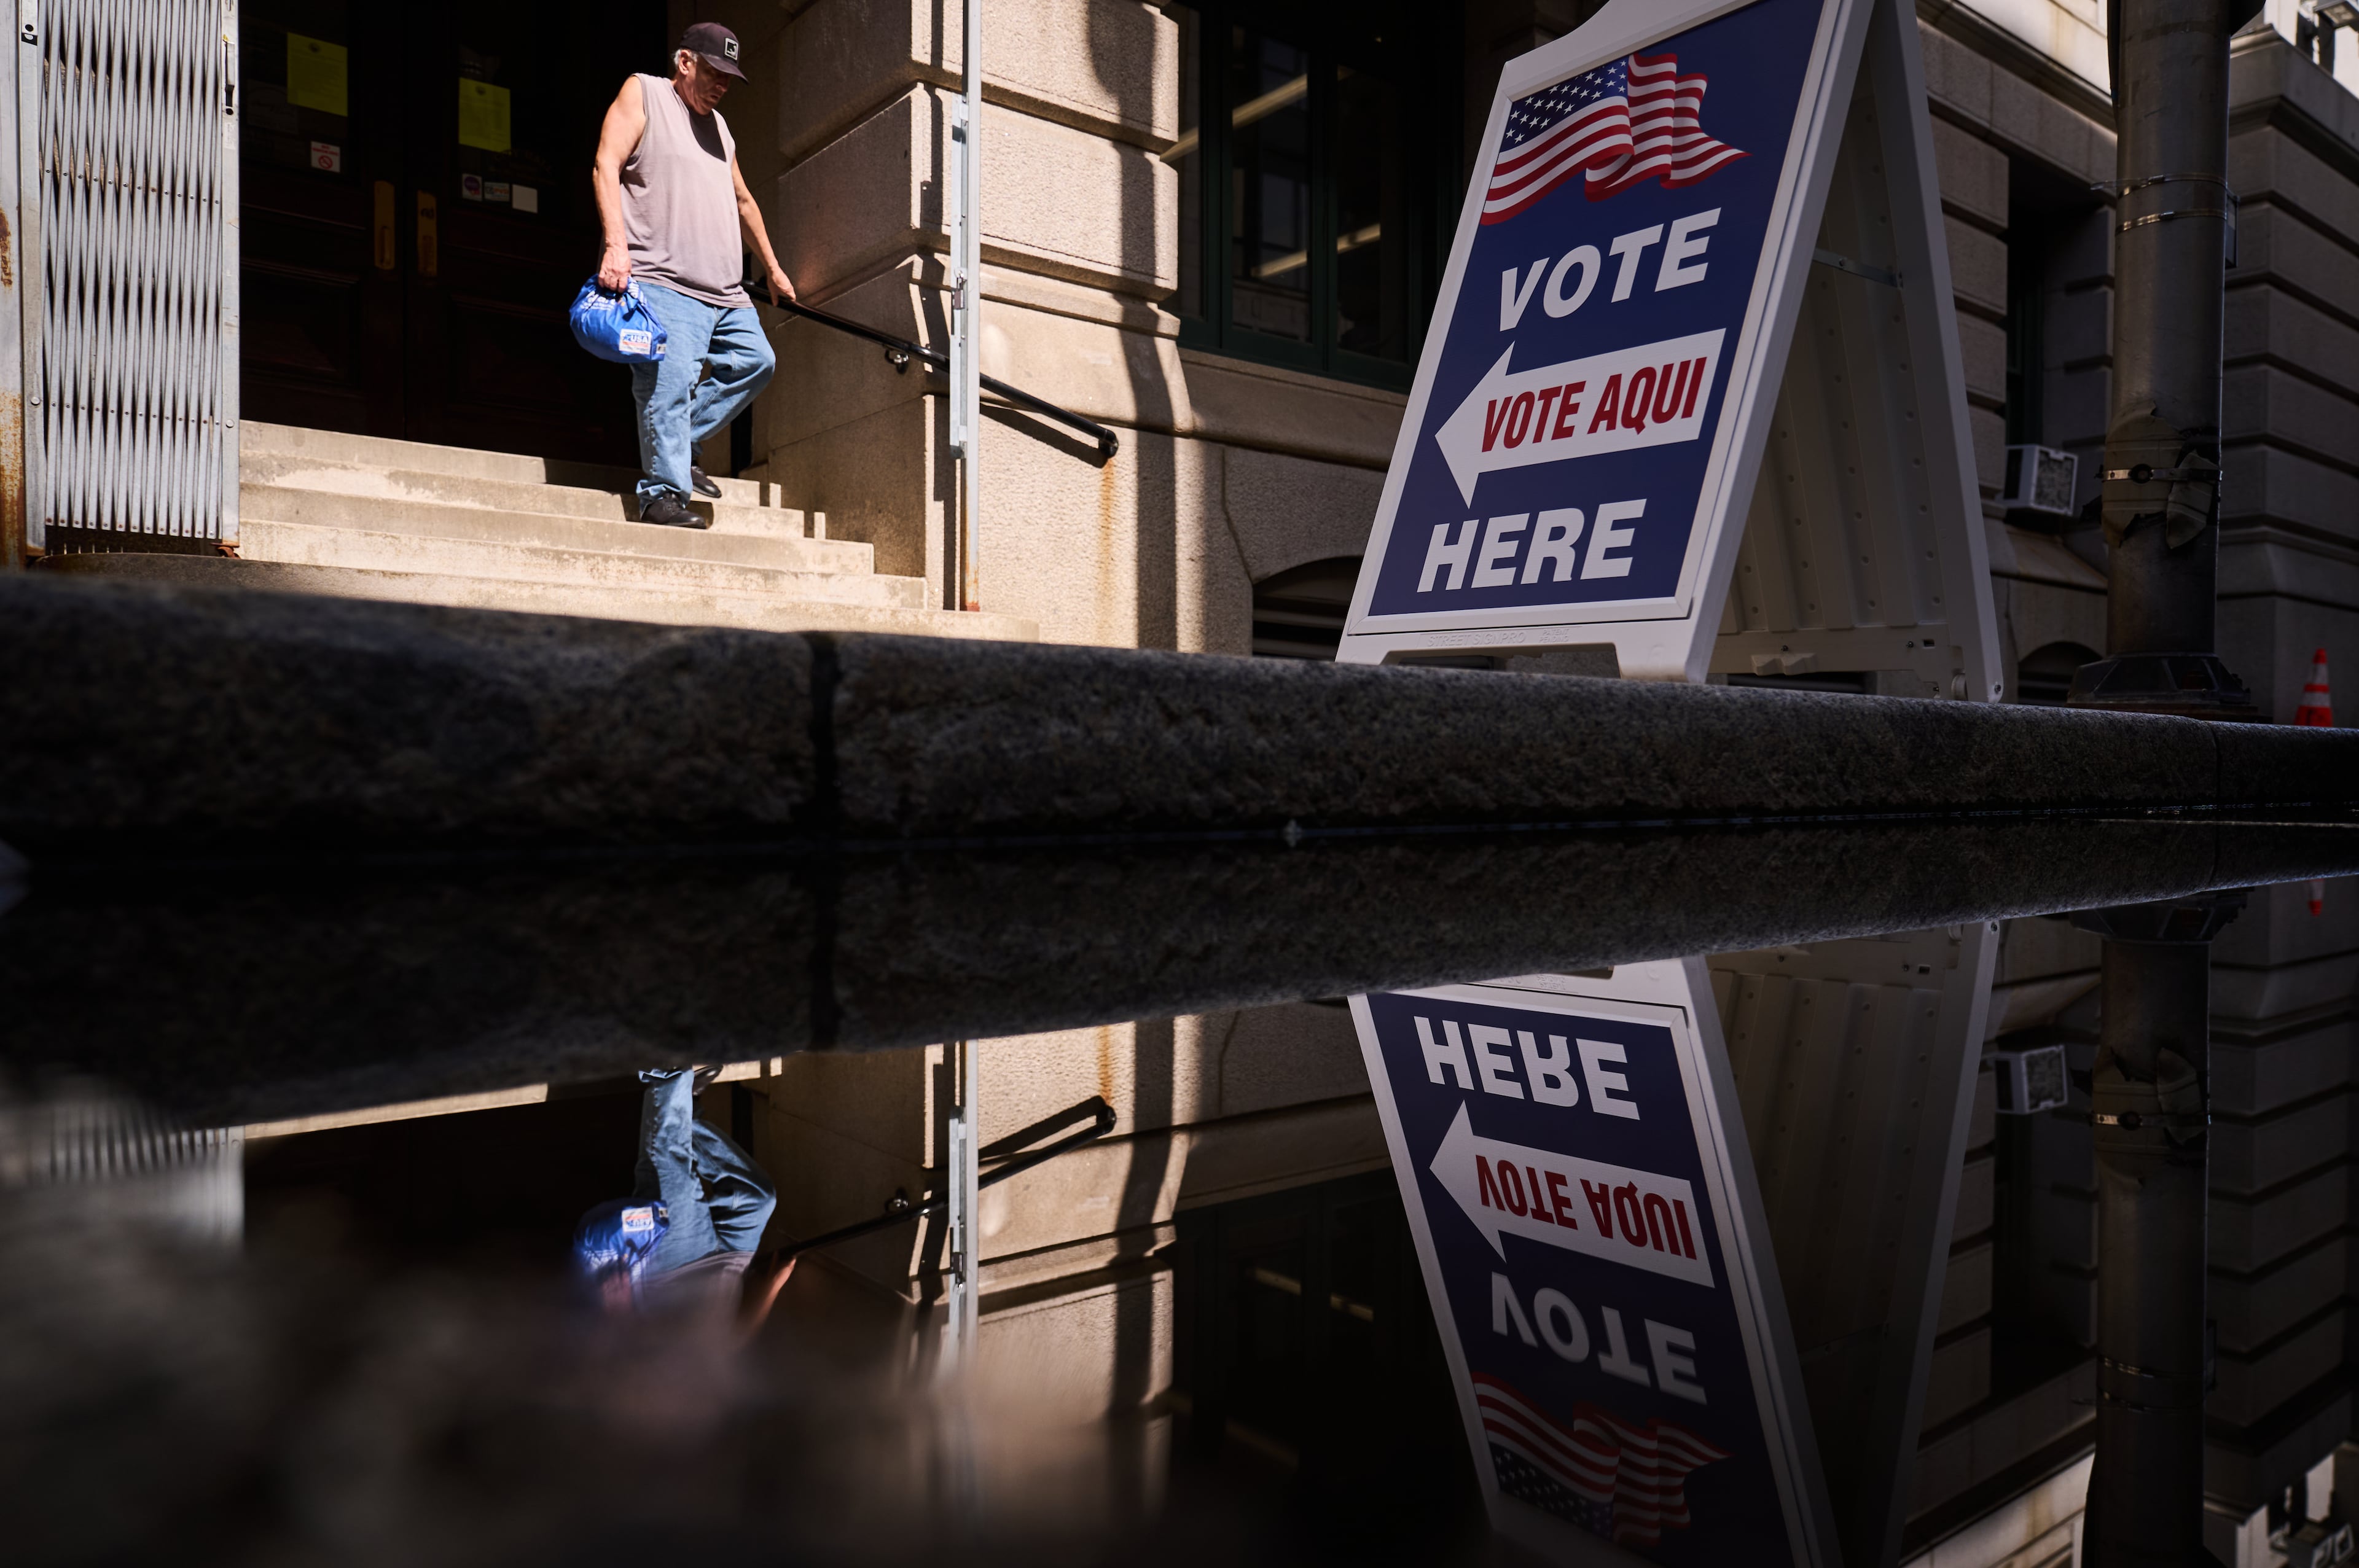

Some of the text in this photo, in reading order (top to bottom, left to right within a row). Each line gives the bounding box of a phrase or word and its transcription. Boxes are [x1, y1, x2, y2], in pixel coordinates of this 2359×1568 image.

[1500, 207, 1721, 332] VOTE
[630, 335, 648, 344] USA
[1482, 357, 1707, 453] VOTE AQUI
[1417, 498, 1647, 593] HERE
[1427, 634, 1472, 647] STREET
